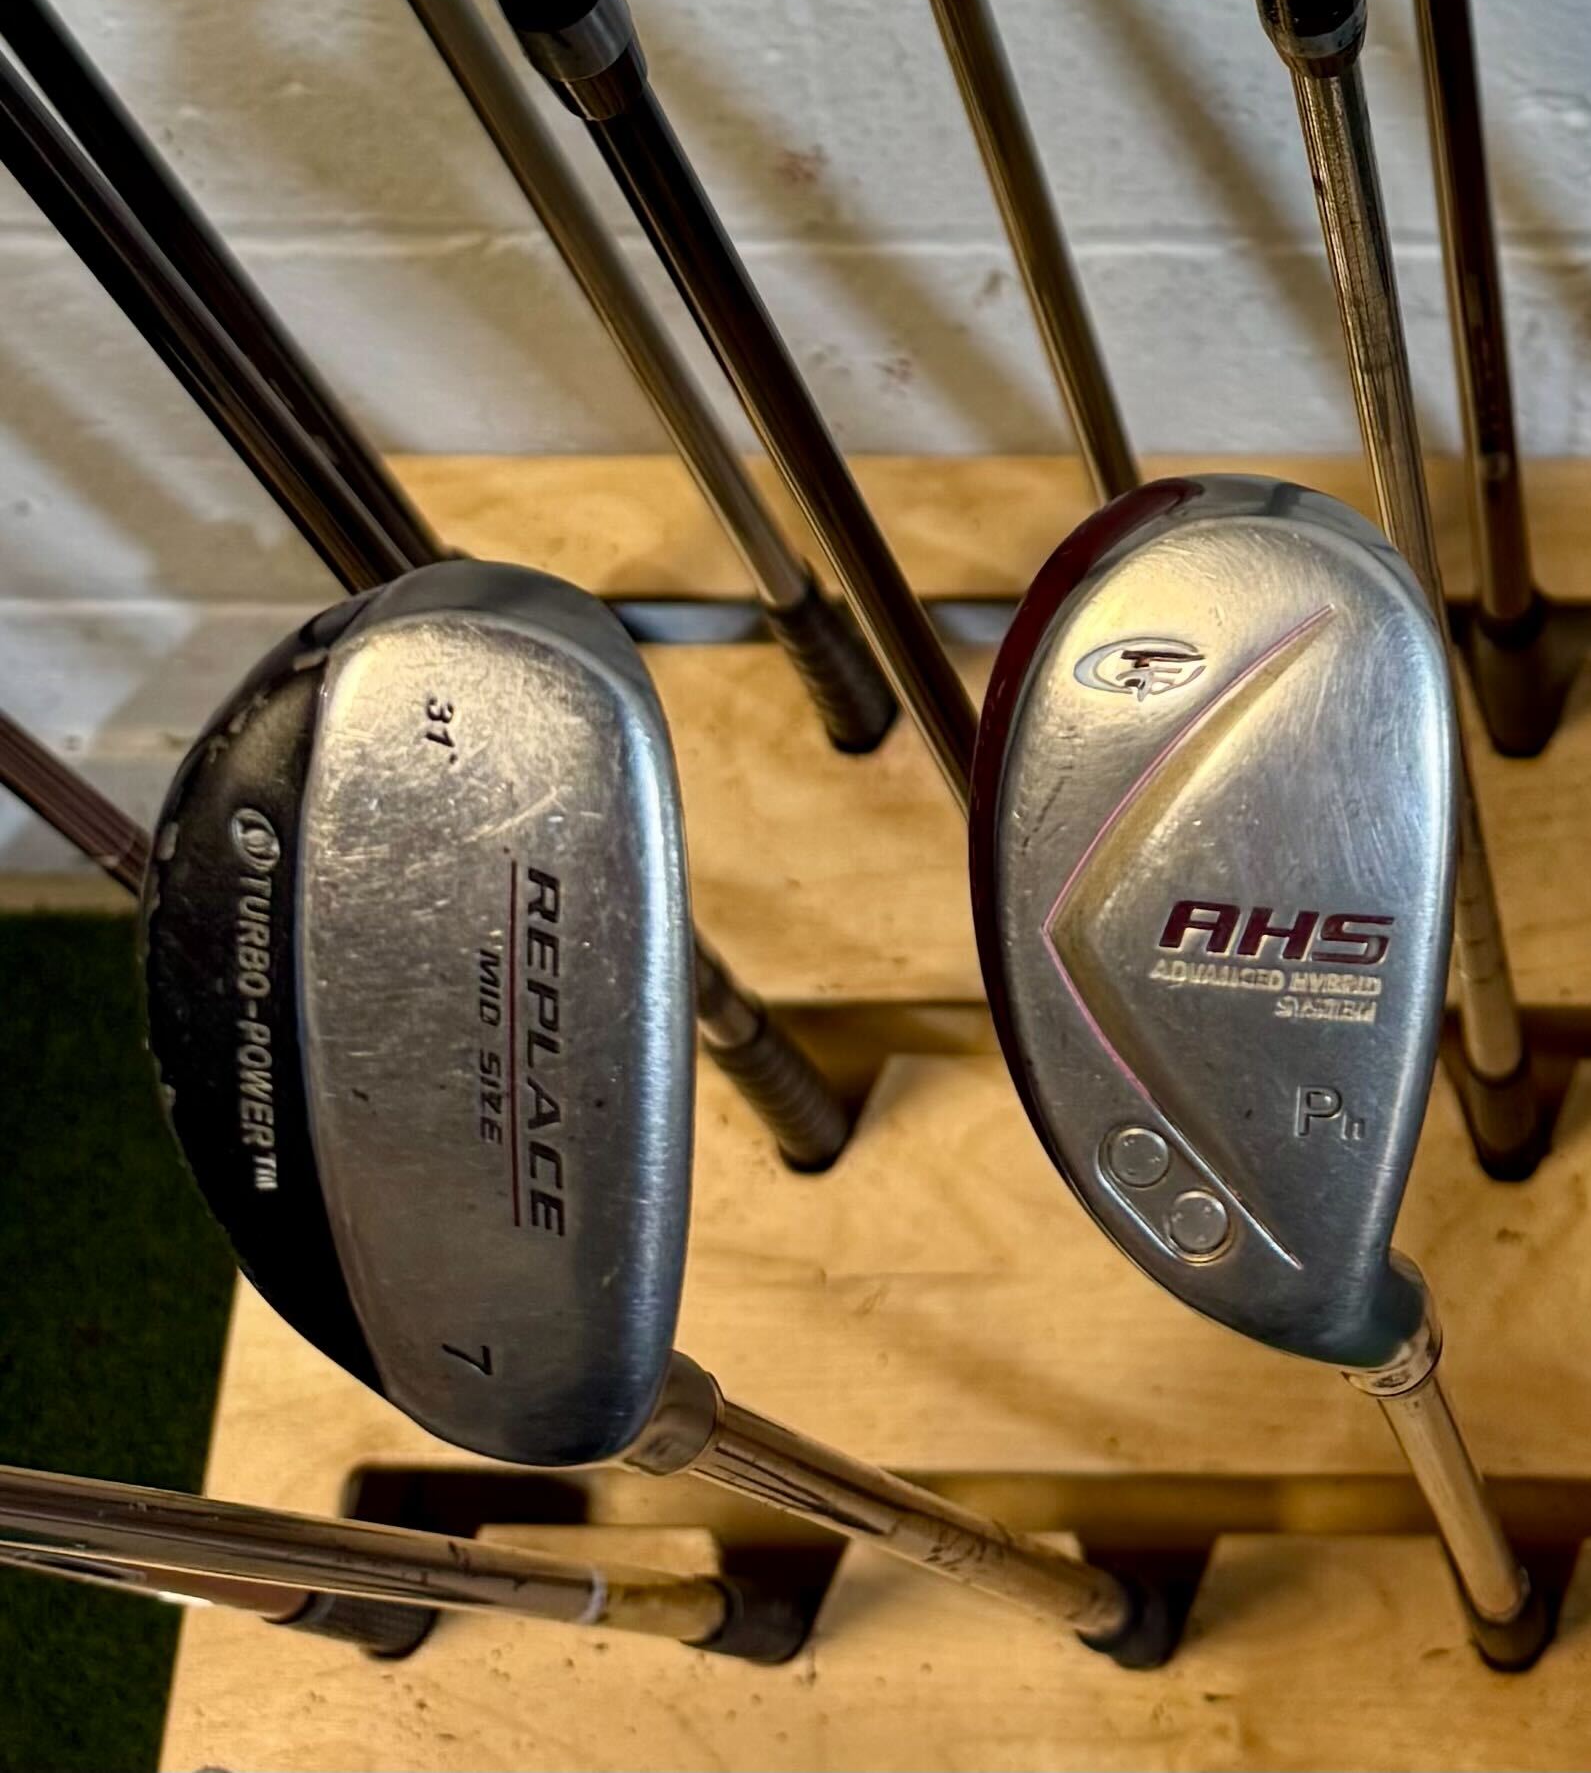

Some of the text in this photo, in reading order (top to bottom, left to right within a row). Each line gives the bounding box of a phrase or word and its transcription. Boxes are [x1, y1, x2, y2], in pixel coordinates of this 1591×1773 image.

[1158, 900, 1395, 966] AHS
[1150, 959, 1382, 996] ADVANCED HYBRID
[477, 949, 504, 1146] MID SIZE
[526, 868, 569, 1238] REPLACE
[442, 1343, 492, 1378] 7
